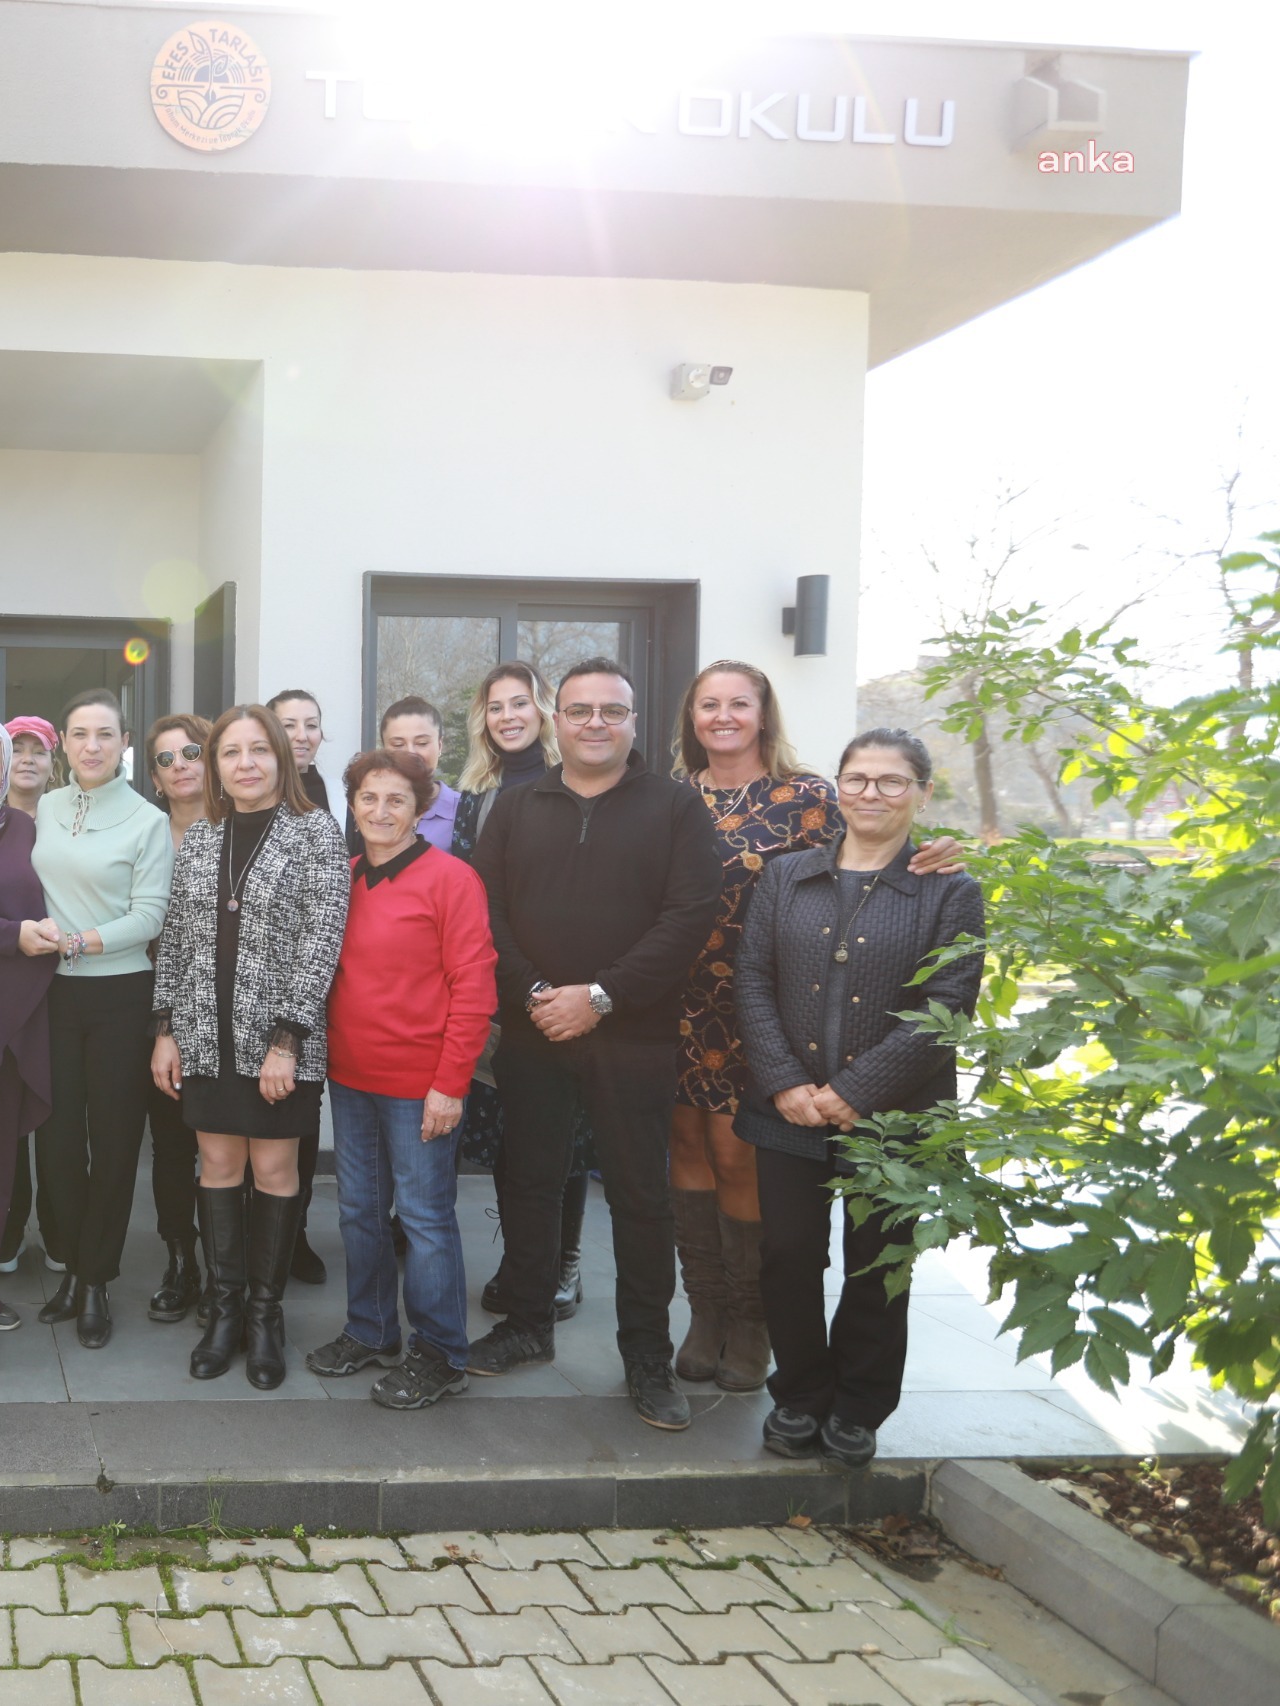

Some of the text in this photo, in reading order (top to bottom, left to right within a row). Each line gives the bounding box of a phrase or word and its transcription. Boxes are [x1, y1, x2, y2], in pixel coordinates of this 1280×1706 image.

[162, 28, 264, 83] EFES TARLASI
[678, 89, 956, 147] OKULU
